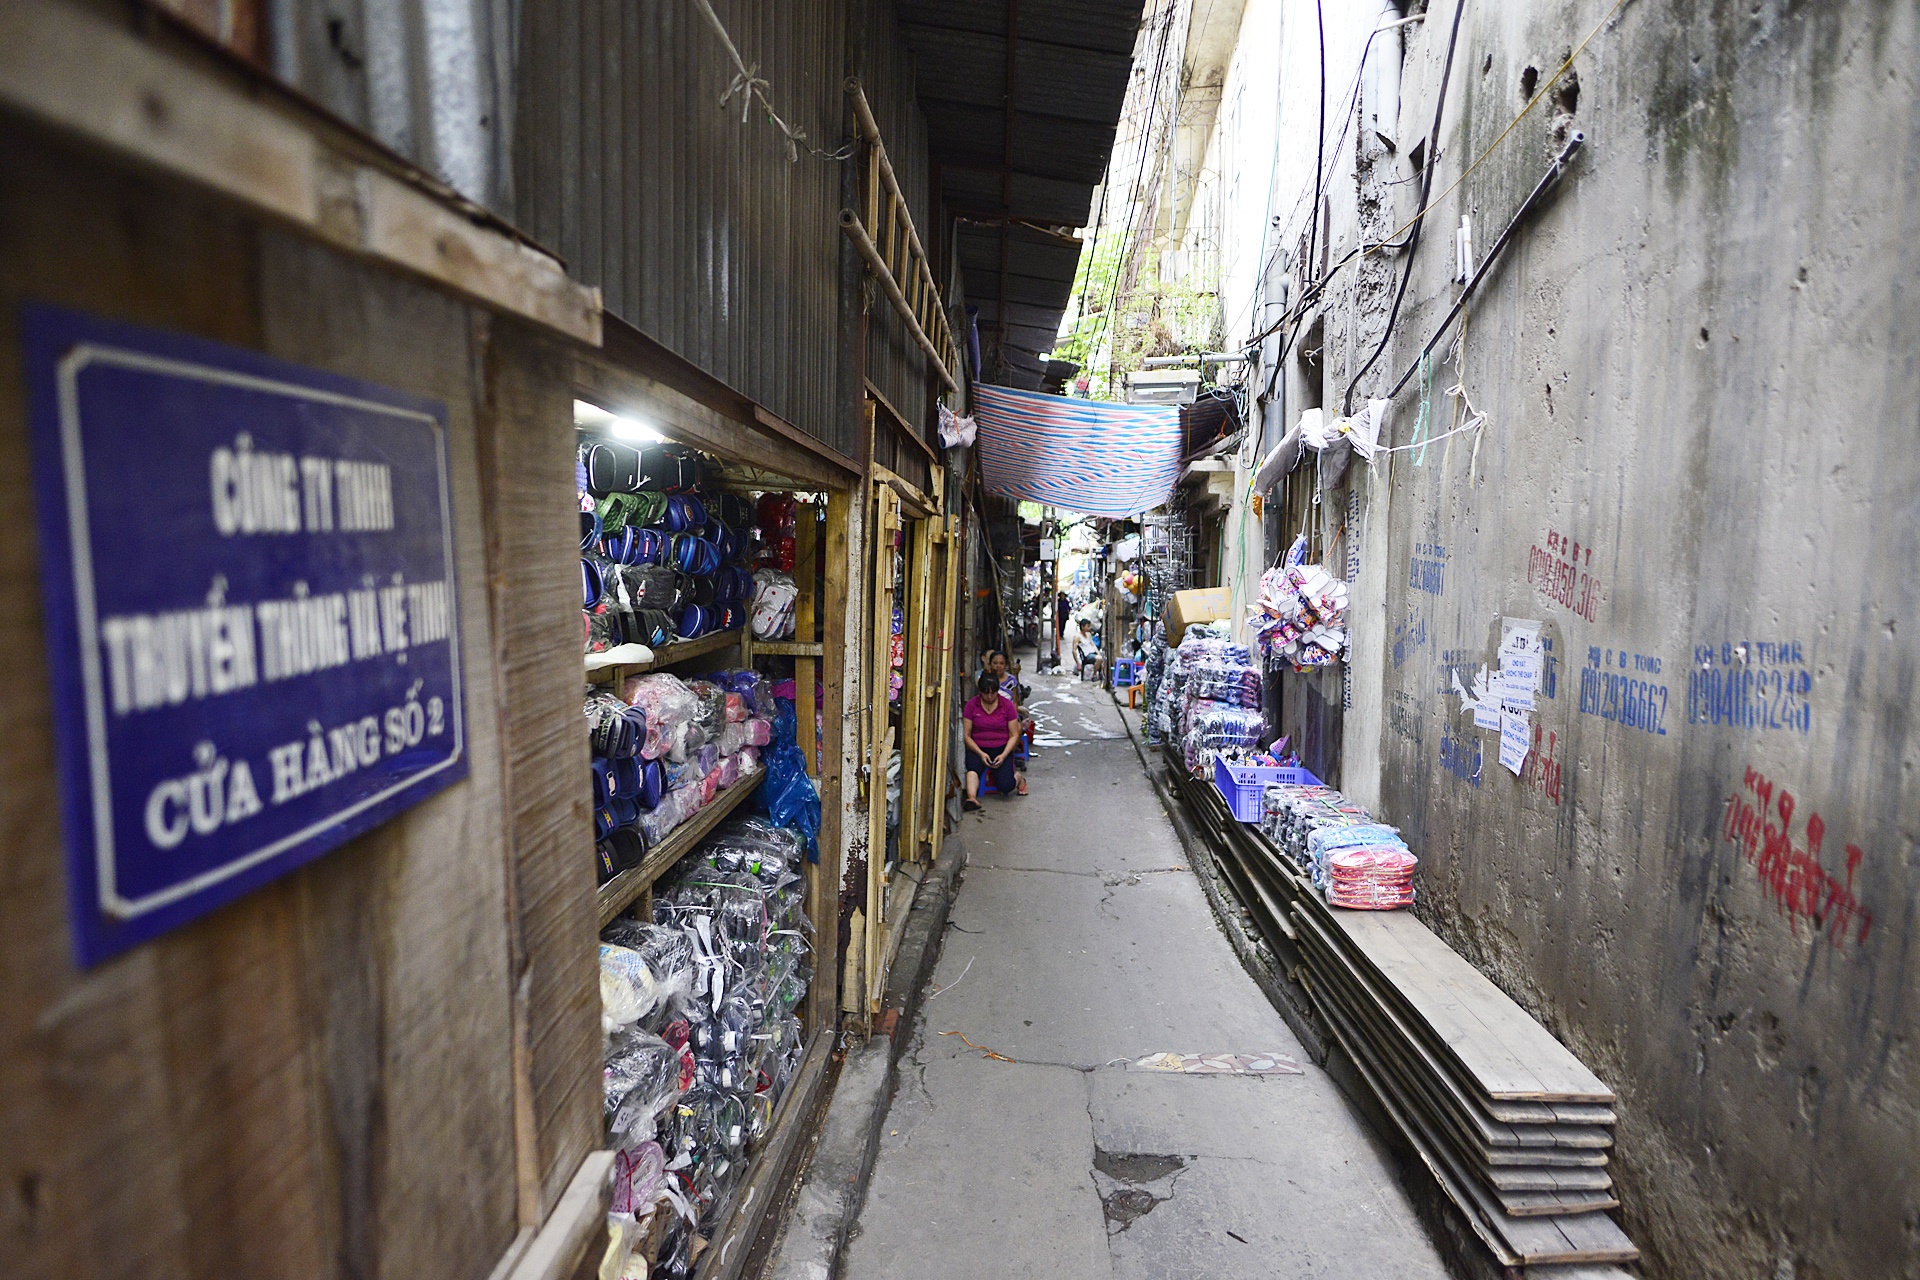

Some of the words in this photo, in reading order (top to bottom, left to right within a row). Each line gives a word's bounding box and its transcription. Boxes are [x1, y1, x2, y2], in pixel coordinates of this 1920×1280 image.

[210, 433, 299, 535] CÔNG
[301, 457, 333, 532] TY
[1580, 666, 1668, 736] 0912936662
[145, 740, 265, 849] CỬA
[268, 720, 382, 804] HÀNG
[384, 677, 426, 755] SỐ
[426, 697, 445, 736] 2
